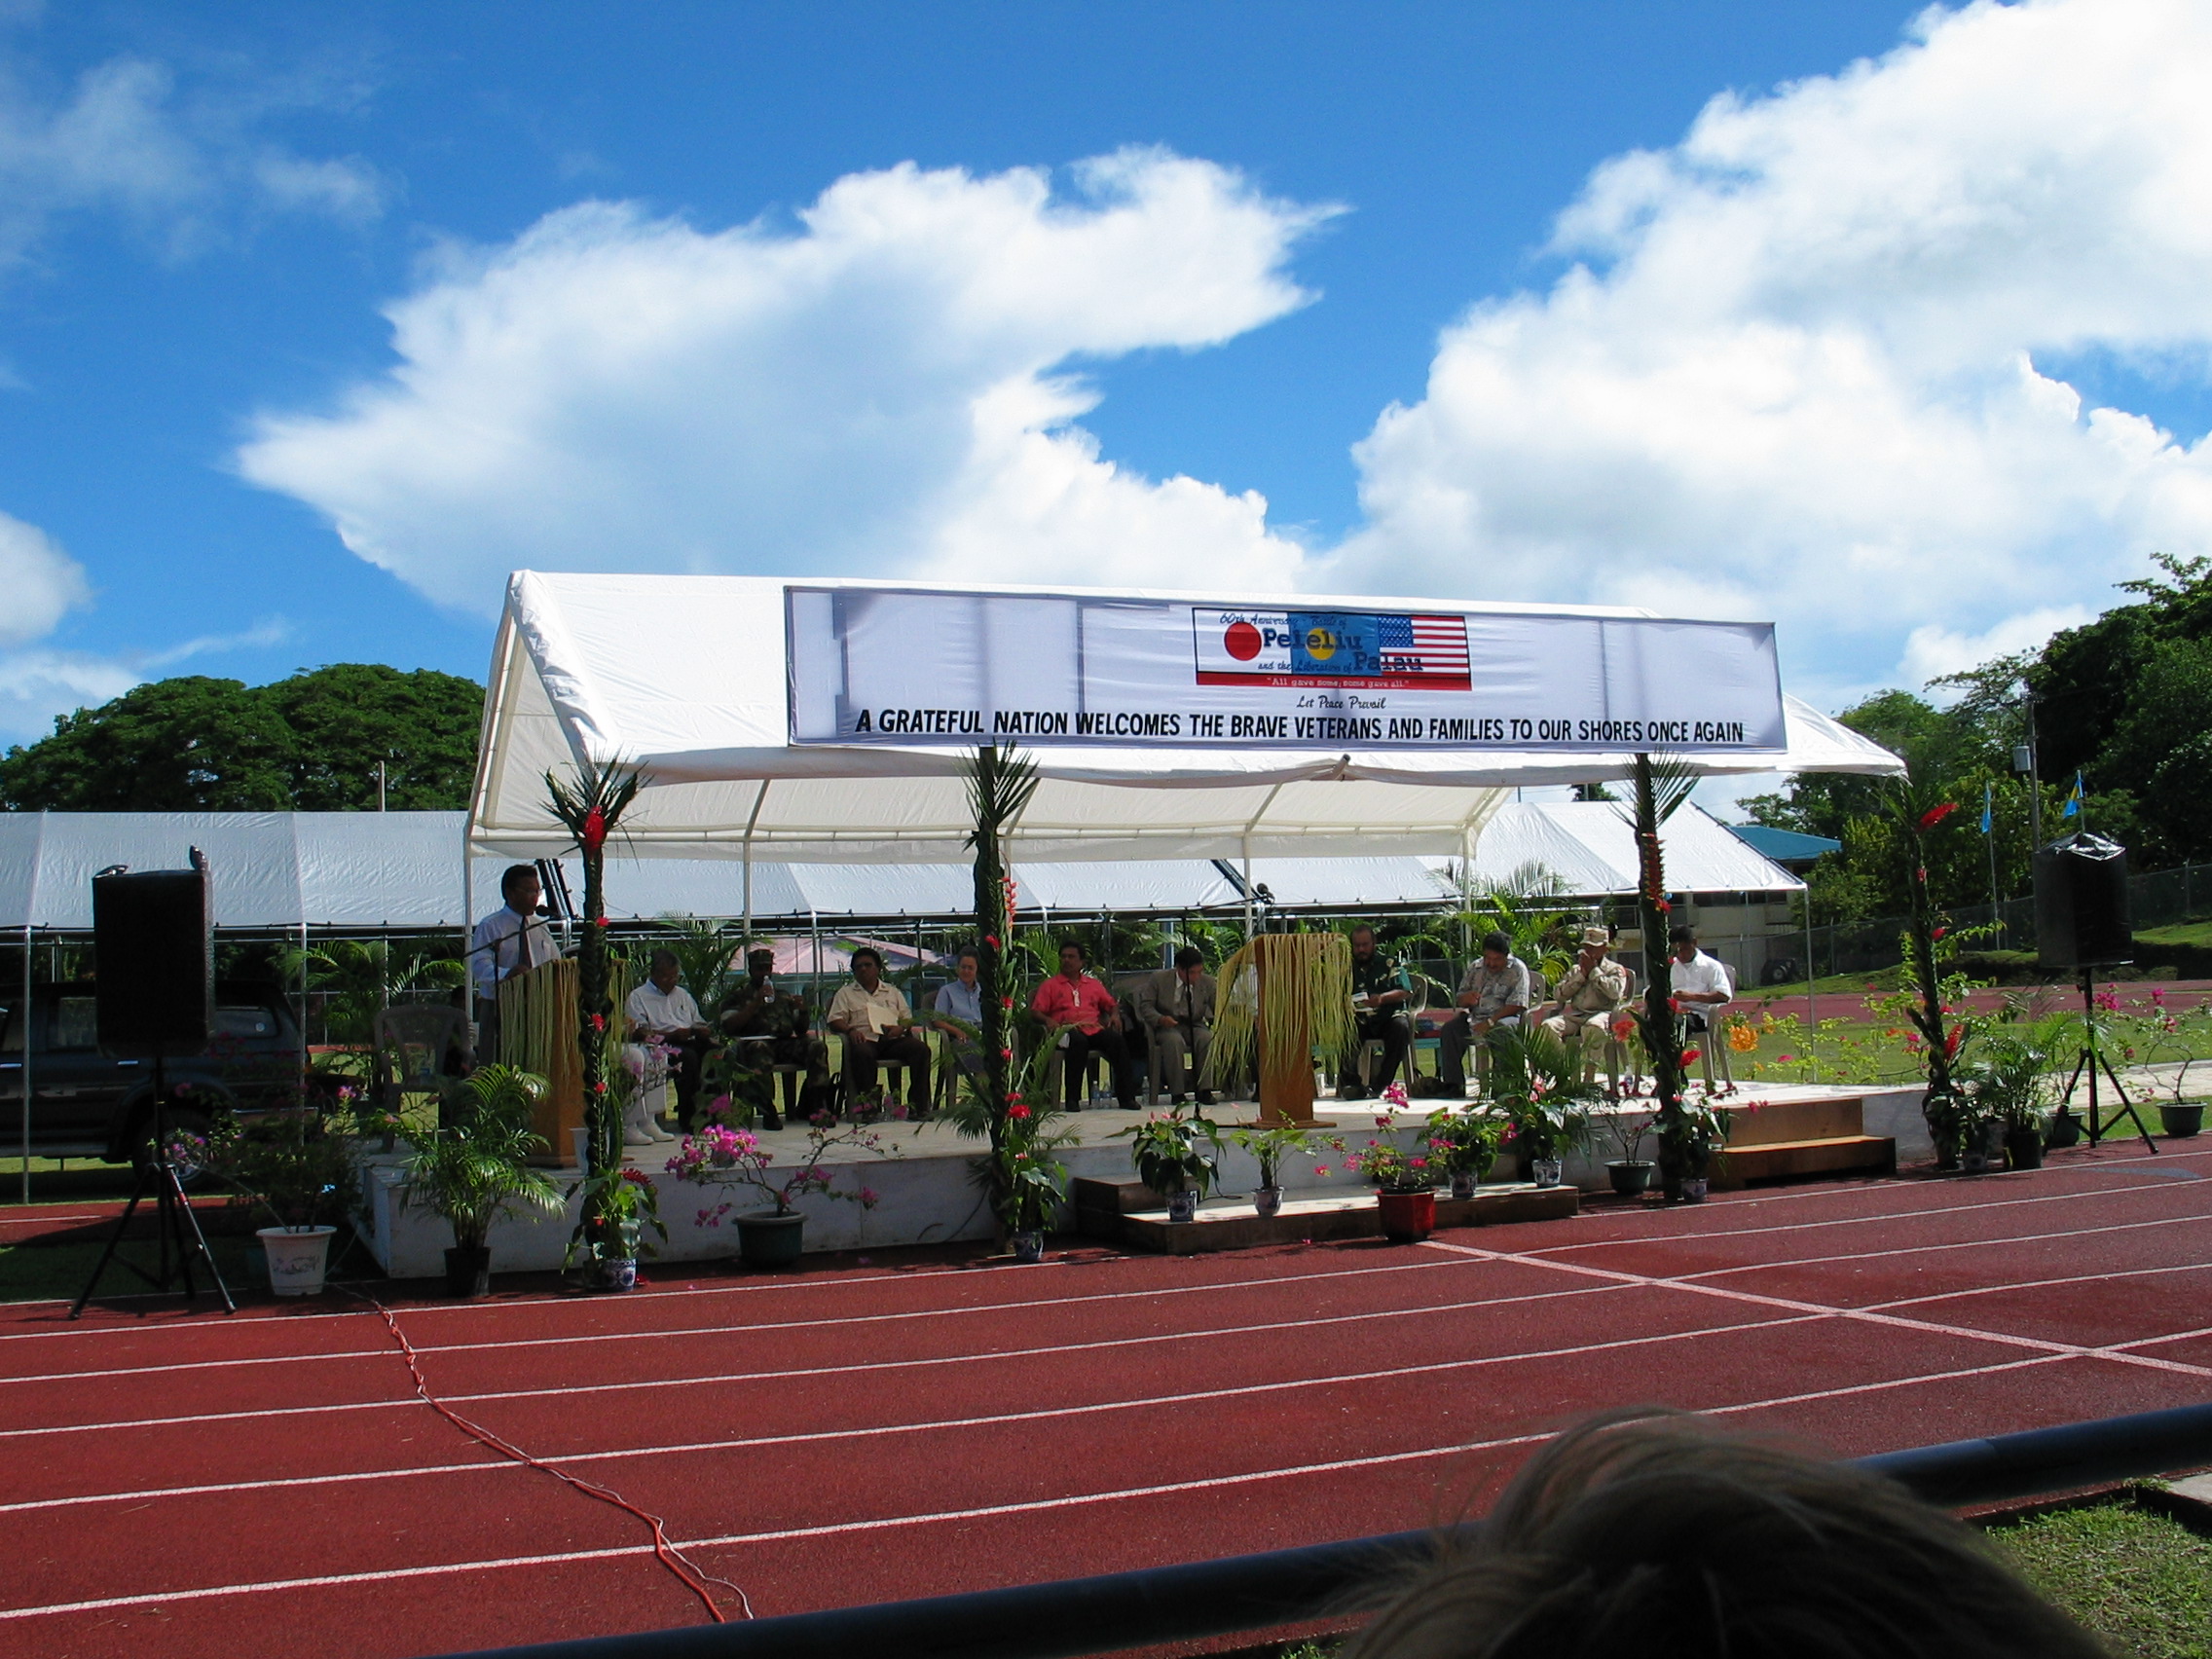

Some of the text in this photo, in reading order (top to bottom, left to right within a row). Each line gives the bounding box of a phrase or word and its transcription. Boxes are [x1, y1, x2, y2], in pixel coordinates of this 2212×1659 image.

[1263, 628, 1362, 650] Peleliu
[1343, 662, 1352, 674] of
[1353, 651, 1423, 672] Palau
[1296, 694, 1386, 709] Let Peace Prevail
[855, 709, 1743, 742] A GRATEFUL NATION WELCOMES THE BRAVE VETERANS AND FAMILIES TO OUR SHORES ONCE AGAIN
